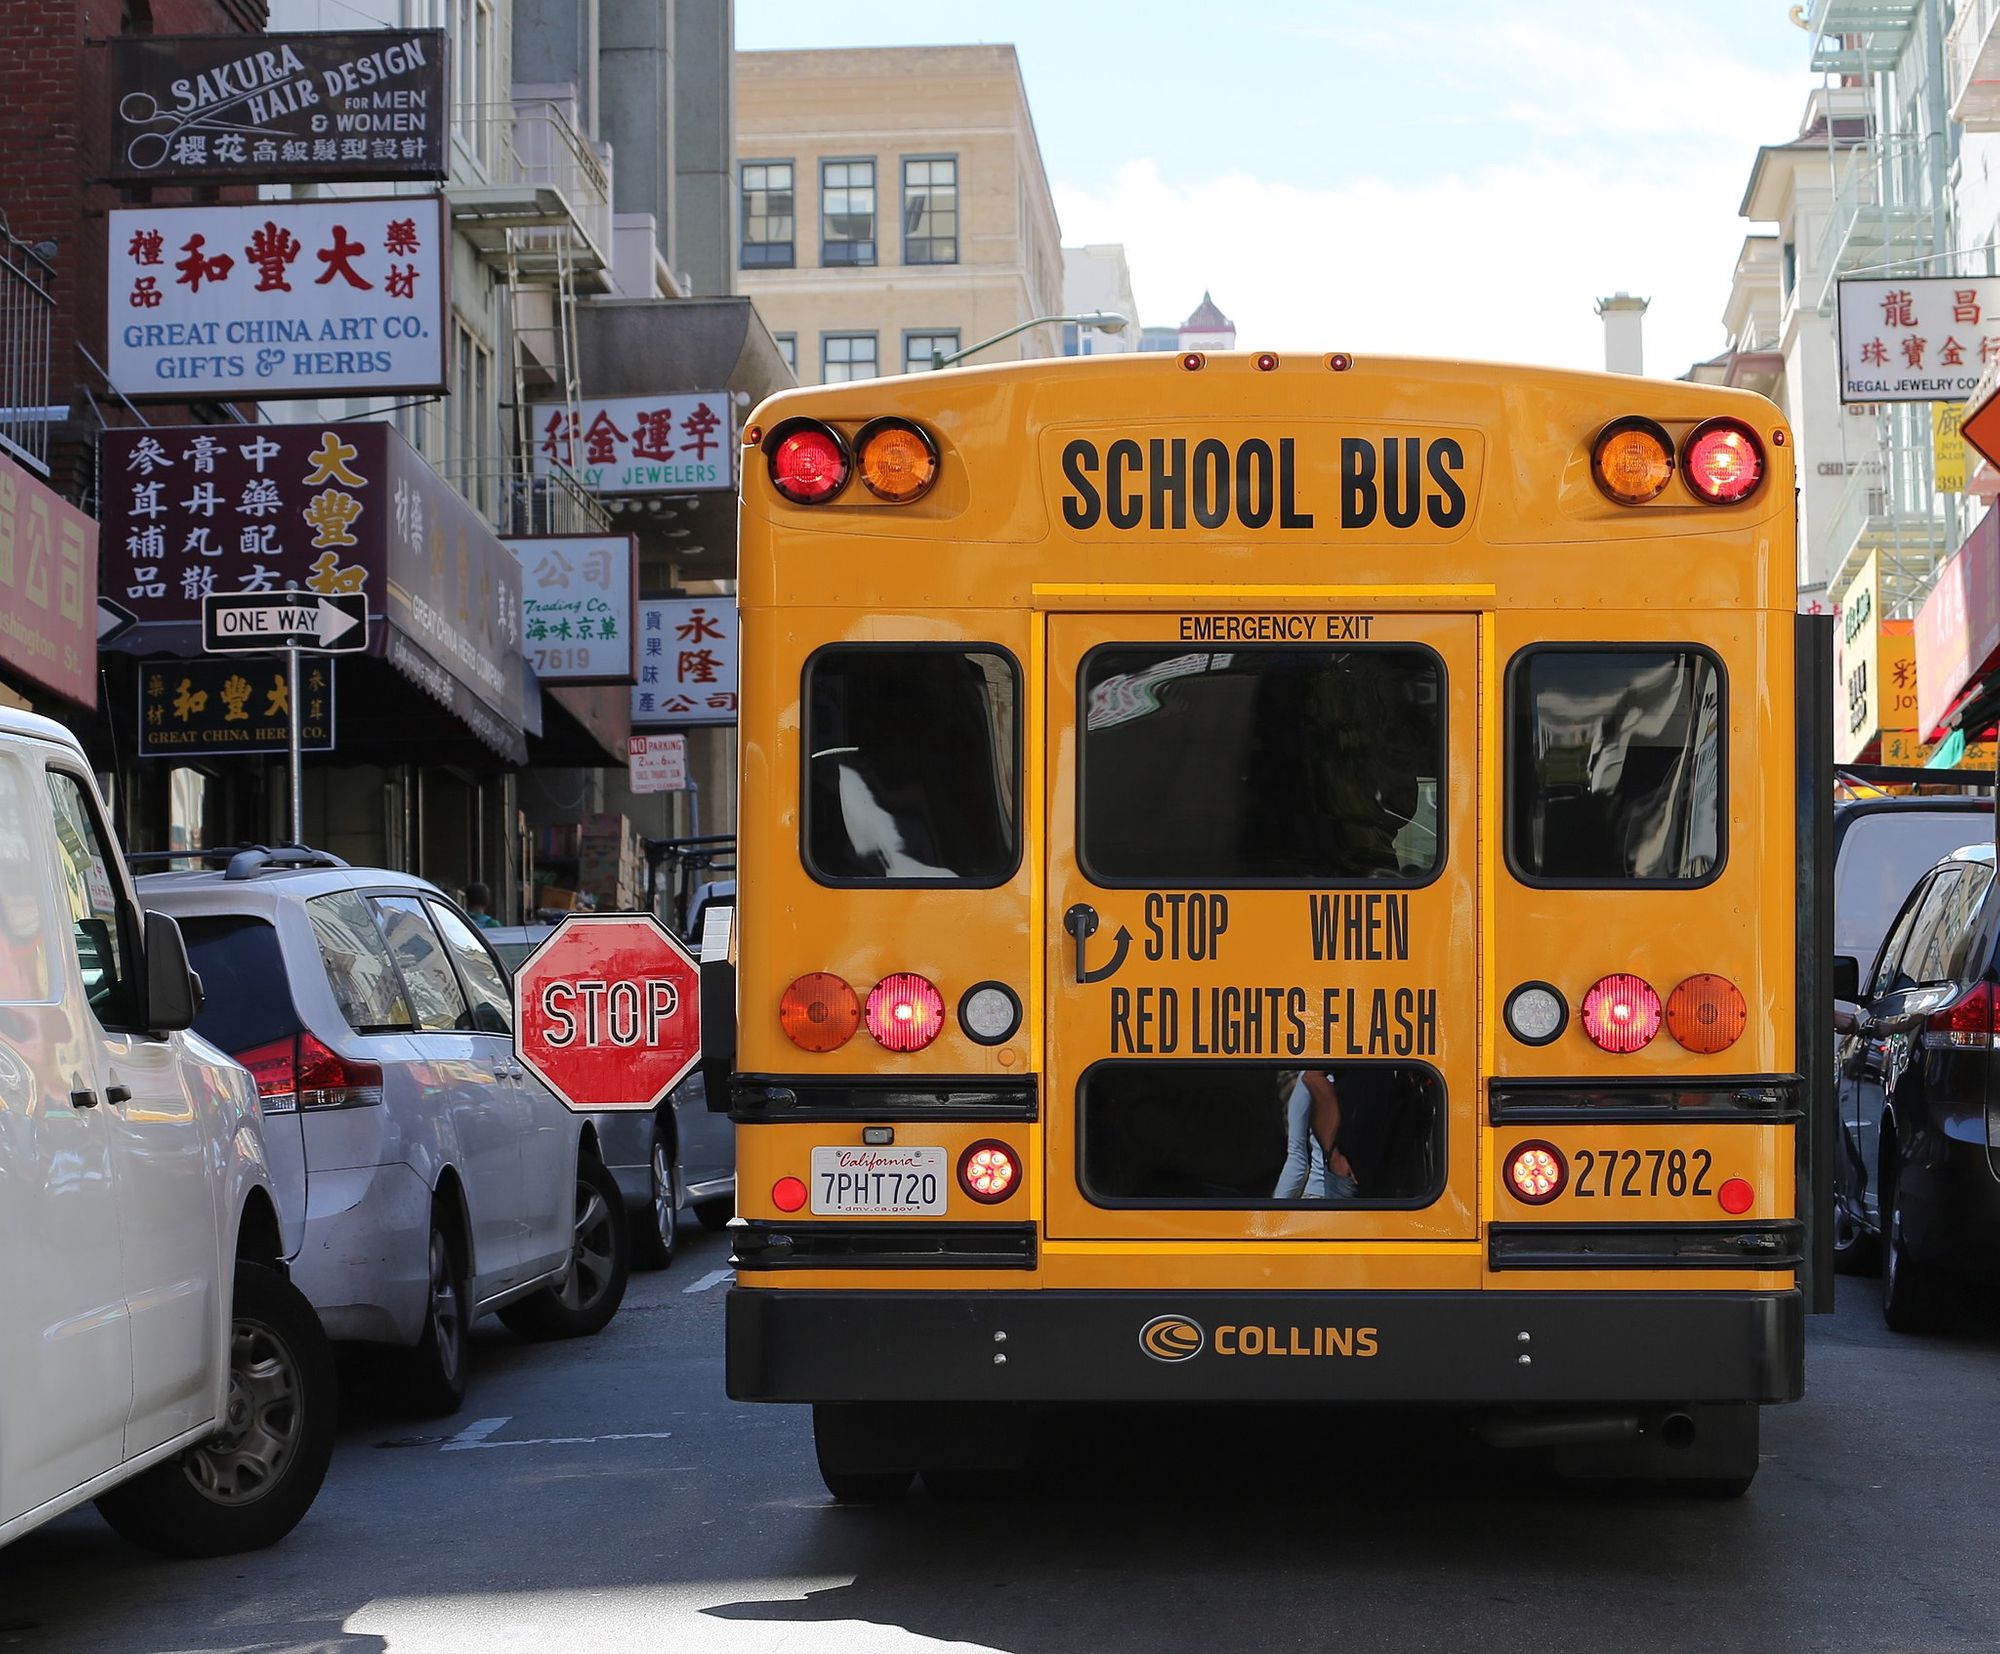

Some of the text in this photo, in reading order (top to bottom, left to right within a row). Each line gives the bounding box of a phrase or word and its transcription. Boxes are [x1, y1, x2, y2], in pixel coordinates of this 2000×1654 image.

[171, 44, 304, 112] SAKURA
[249, 39, 427, 125] HAIR DESIGN
[345, 90, 427, 110] FOR MEN
[311, 113, 427, 132] & WOMEN
[123, 315, 430, 349] GREAT CHINA ART CO.
[155, 348, 392, 379] GIFTS & HERBS
[1847, 380, 1890, 392] REGAL
[1893, 378, 1954, 392] JEWELRY
[622, 464, 717, 486] JEWELERS
[1061, 437, 1467, 530] SCHOOL BUS
[223, 610, 319, 633] ONE WAY
[412, 594, 437, 635] GREAT
[1179, 615, 1374, 640] EMERGENCY EXIT
[148, 731, 198, 744] GREAT
[202, 730, 249, 742] CHINA
[255, 728, 288, 741] HER
[631, 738, 681, 753] NO PARKING
[1144, 892, 1409, 961] STOP WHEN
[542, 980, 679, 1048] STOP
[1111, 986, 1437, 1056] RED LIGHTS FLASH
[840, 1152, 922, 1171] California
[1574, 1149, 1712, 1197] 272782
[821, 1173, 937, 1204] 7PHT720
[1215, 1325, 1378, 1357] COLLINS
